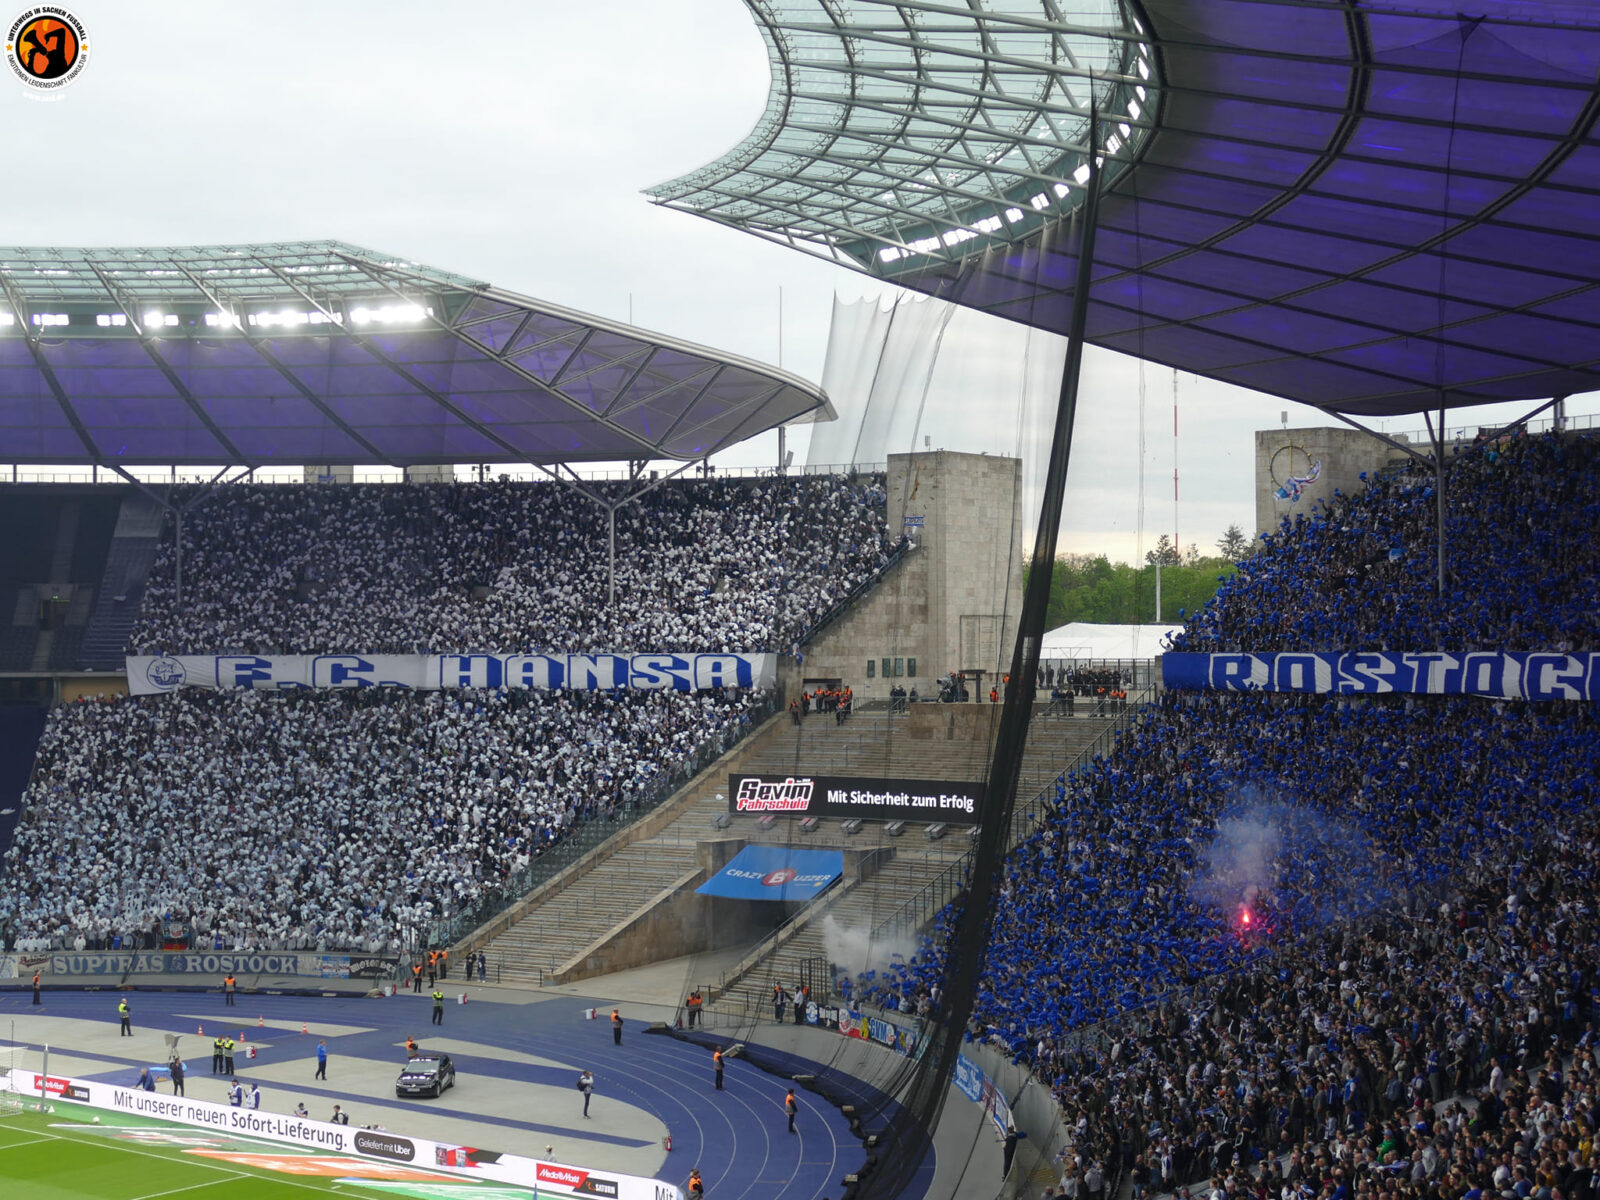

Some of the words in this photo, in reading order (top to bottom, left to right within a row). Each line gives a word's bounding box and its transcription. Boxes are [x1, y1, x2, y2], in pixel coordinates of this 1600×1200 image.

[440, 653, 752, 690] HANSA
[1208, 652, 1600, 701] ROSTOC
[737, 777, 814, 801] Sevim
[737, 798, 809, 811] Fahrschule
[827, 790, 848, 803] Mit
[850, 791, 910, 806] Sicherheit
[911, 795, 937, 807] zum
[939, 795, 974, 813] Erfolg
[726, 868, 765, 880] CRAZY
[185, 955, 297, 974] ROSTOCK
[113, 1090, 133, 1109] Mit
[136, 1095, 184, 1118] unserer
[187, 1107, 228, 1126] neuen
[231, 1111, 348, 1150] Sofort-Lieferung.
[358, 1137, 384, 1151] Geliefert
[384, 1144, 394, 1152] mit
[394, 1146, 411, 1156] Uber
[655, 1185, 675, 1200] Mit
